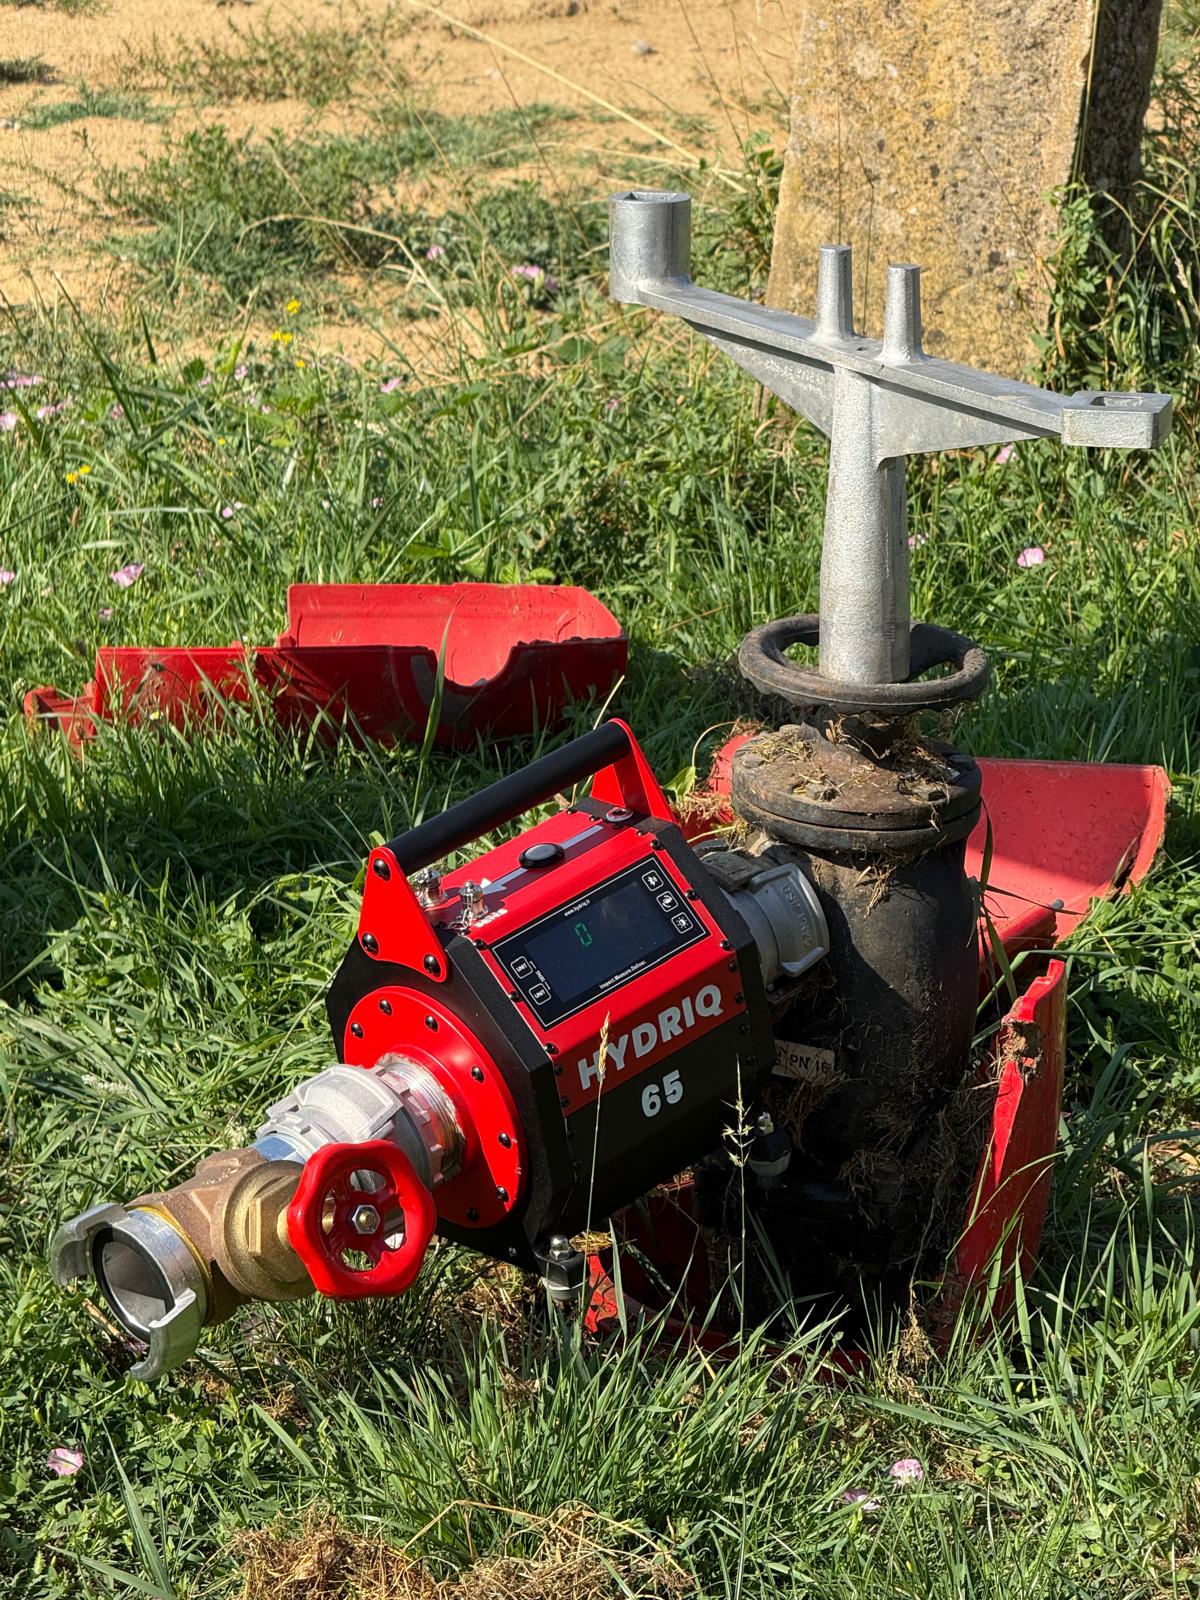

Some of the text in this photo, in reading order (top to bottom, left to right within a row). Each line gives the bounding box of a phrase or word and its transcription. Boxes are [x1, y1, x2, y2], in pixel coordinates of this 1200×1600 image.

[574, 921, 593, 947] 0
[577, 984, 724, 1090] HYDRIQ
[789, 1050, 809, 1070] PN
[641, 1069, 684, 1118] 65
